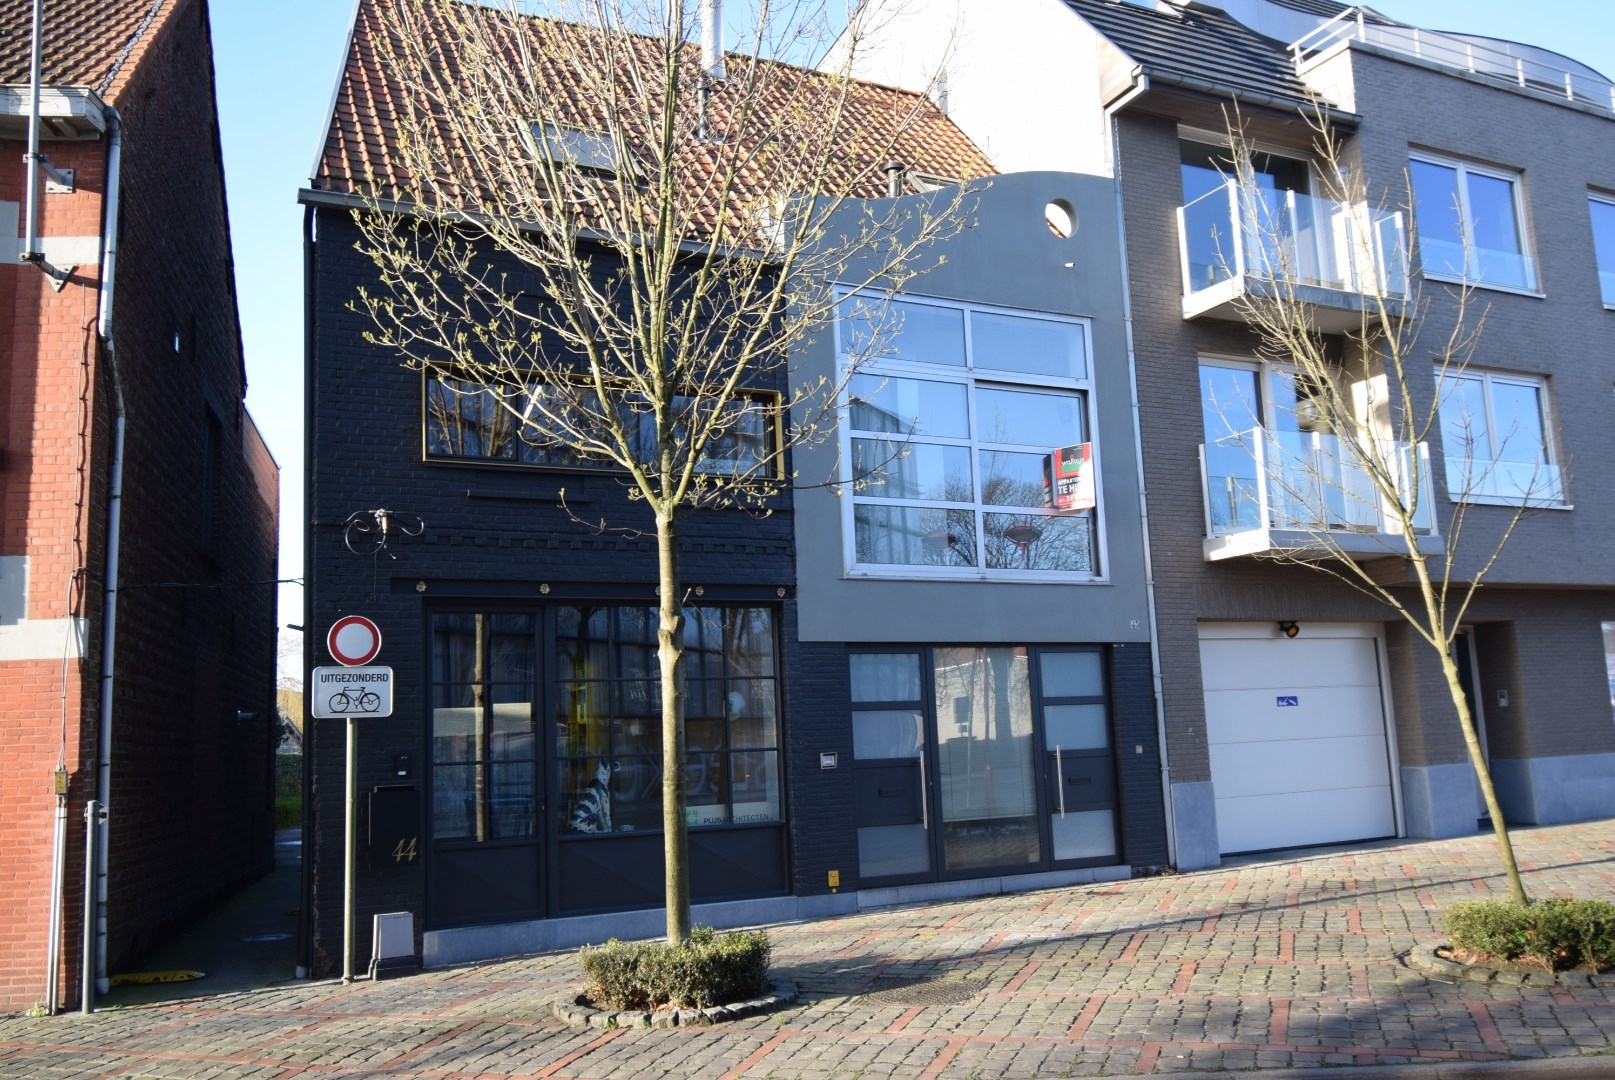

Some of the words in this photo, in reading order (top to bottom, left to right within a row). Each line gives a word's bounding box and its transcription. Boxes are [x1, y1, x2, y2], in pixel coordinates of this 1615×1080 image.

[1057, 485, 1068, 494] TE
[320, 673, 389, 683] UITGEZONDERD
[392, 836, 417, 862] 44
